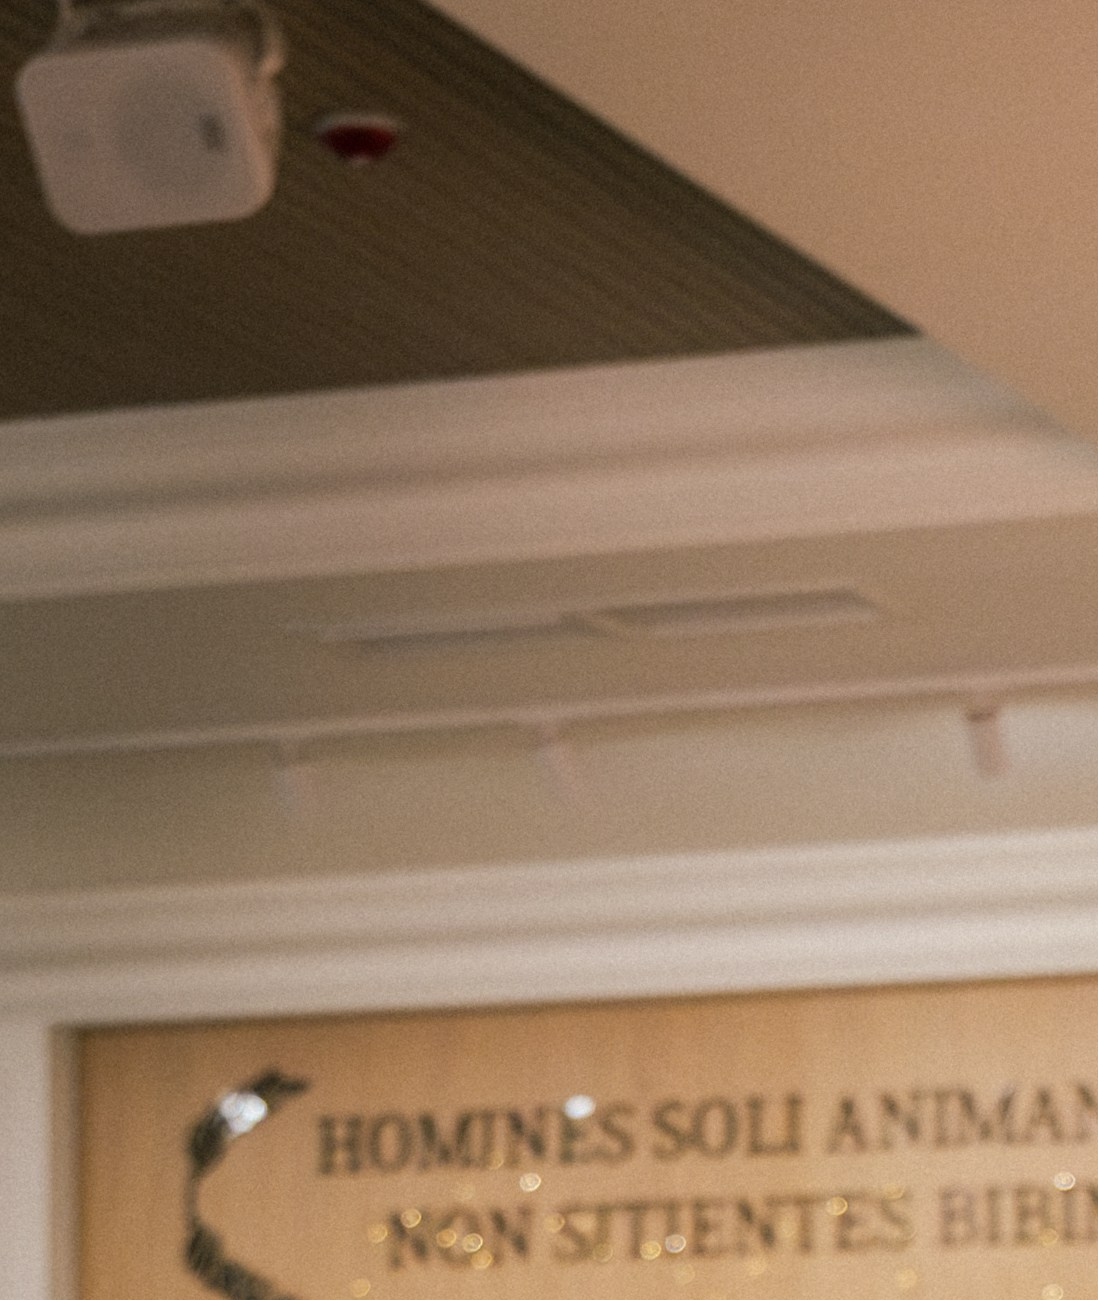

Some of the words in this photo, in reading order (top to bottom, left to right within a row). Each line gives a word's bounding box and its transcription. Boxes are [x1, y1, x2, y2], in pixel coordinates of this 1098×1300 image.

[316, 1103, 638, 1174] HOMINES
[652, 1092, 804, 1160] SOLI
[388, 1205, 534, 1268] NON
